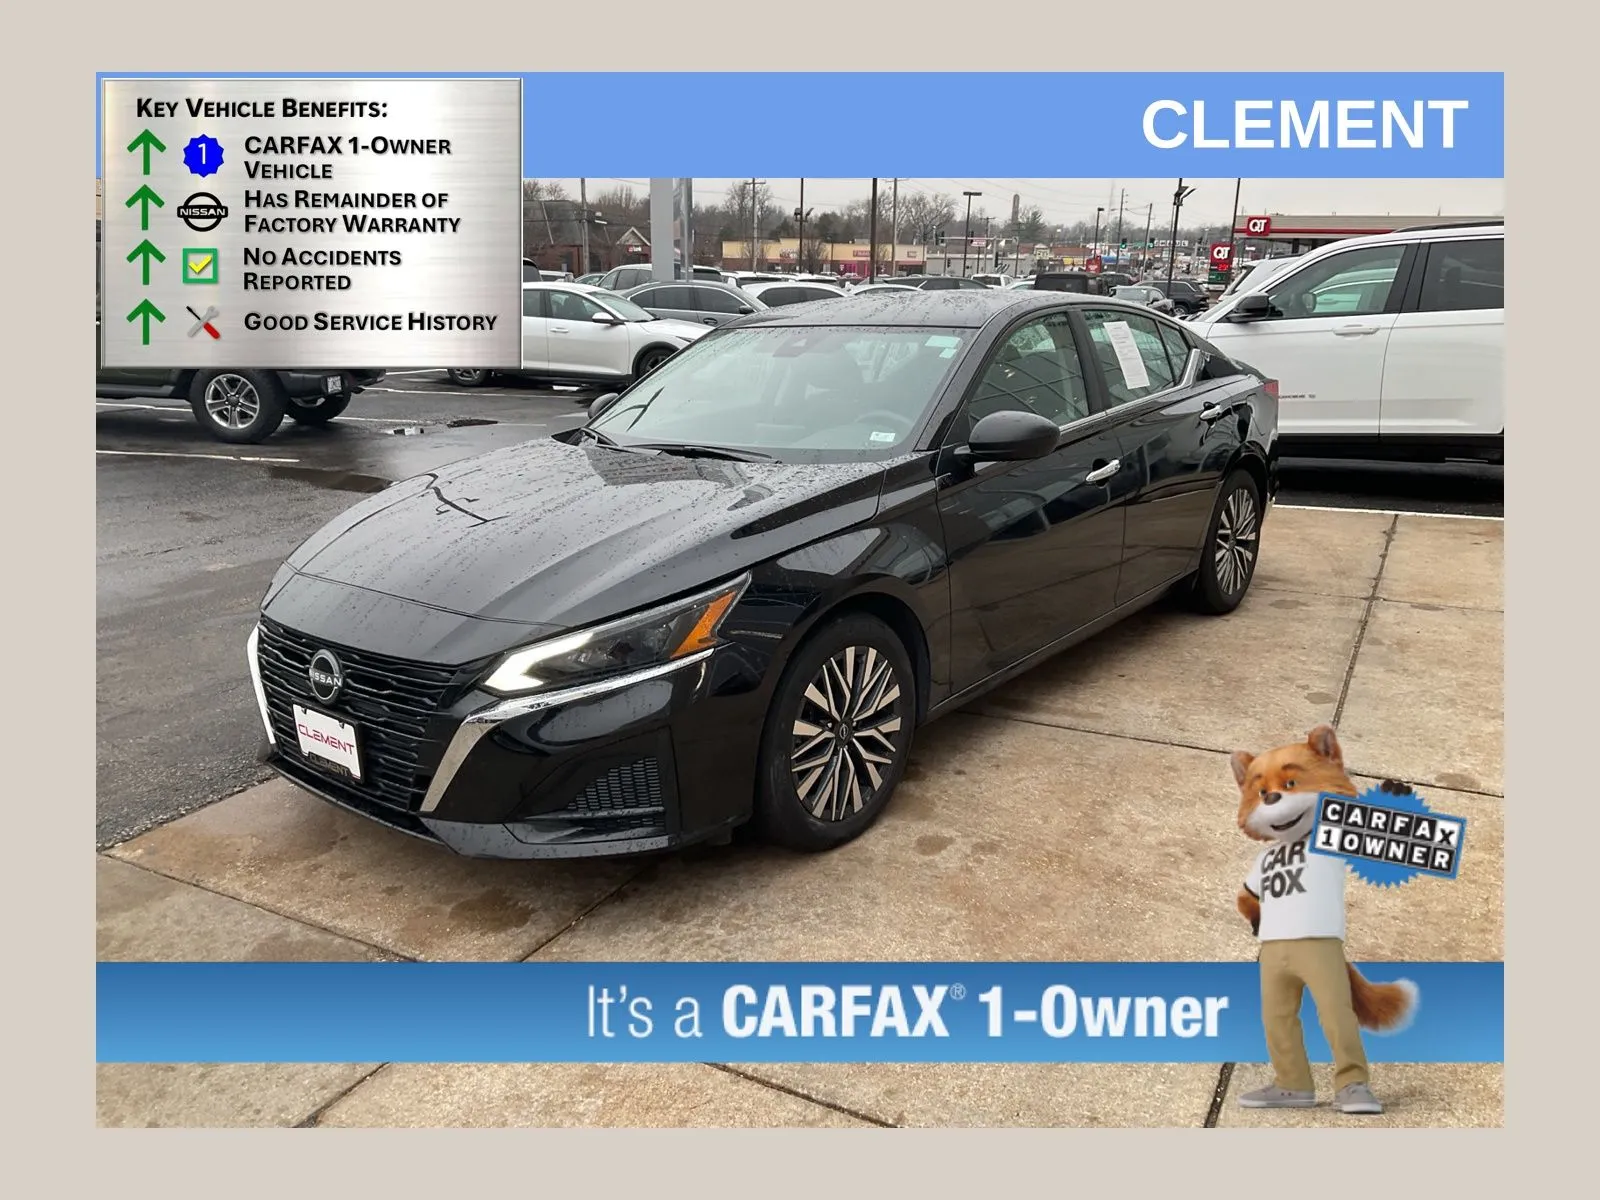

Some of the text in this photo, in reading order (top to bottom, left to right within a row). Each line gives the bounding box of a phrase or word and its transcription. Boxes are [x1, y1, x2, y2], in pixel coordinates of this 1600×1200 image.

[1249, 219, 1267, 232] QT
[1213, 246, 1231, 259] QT
[298, 723, 354, 755] CLEMENT
